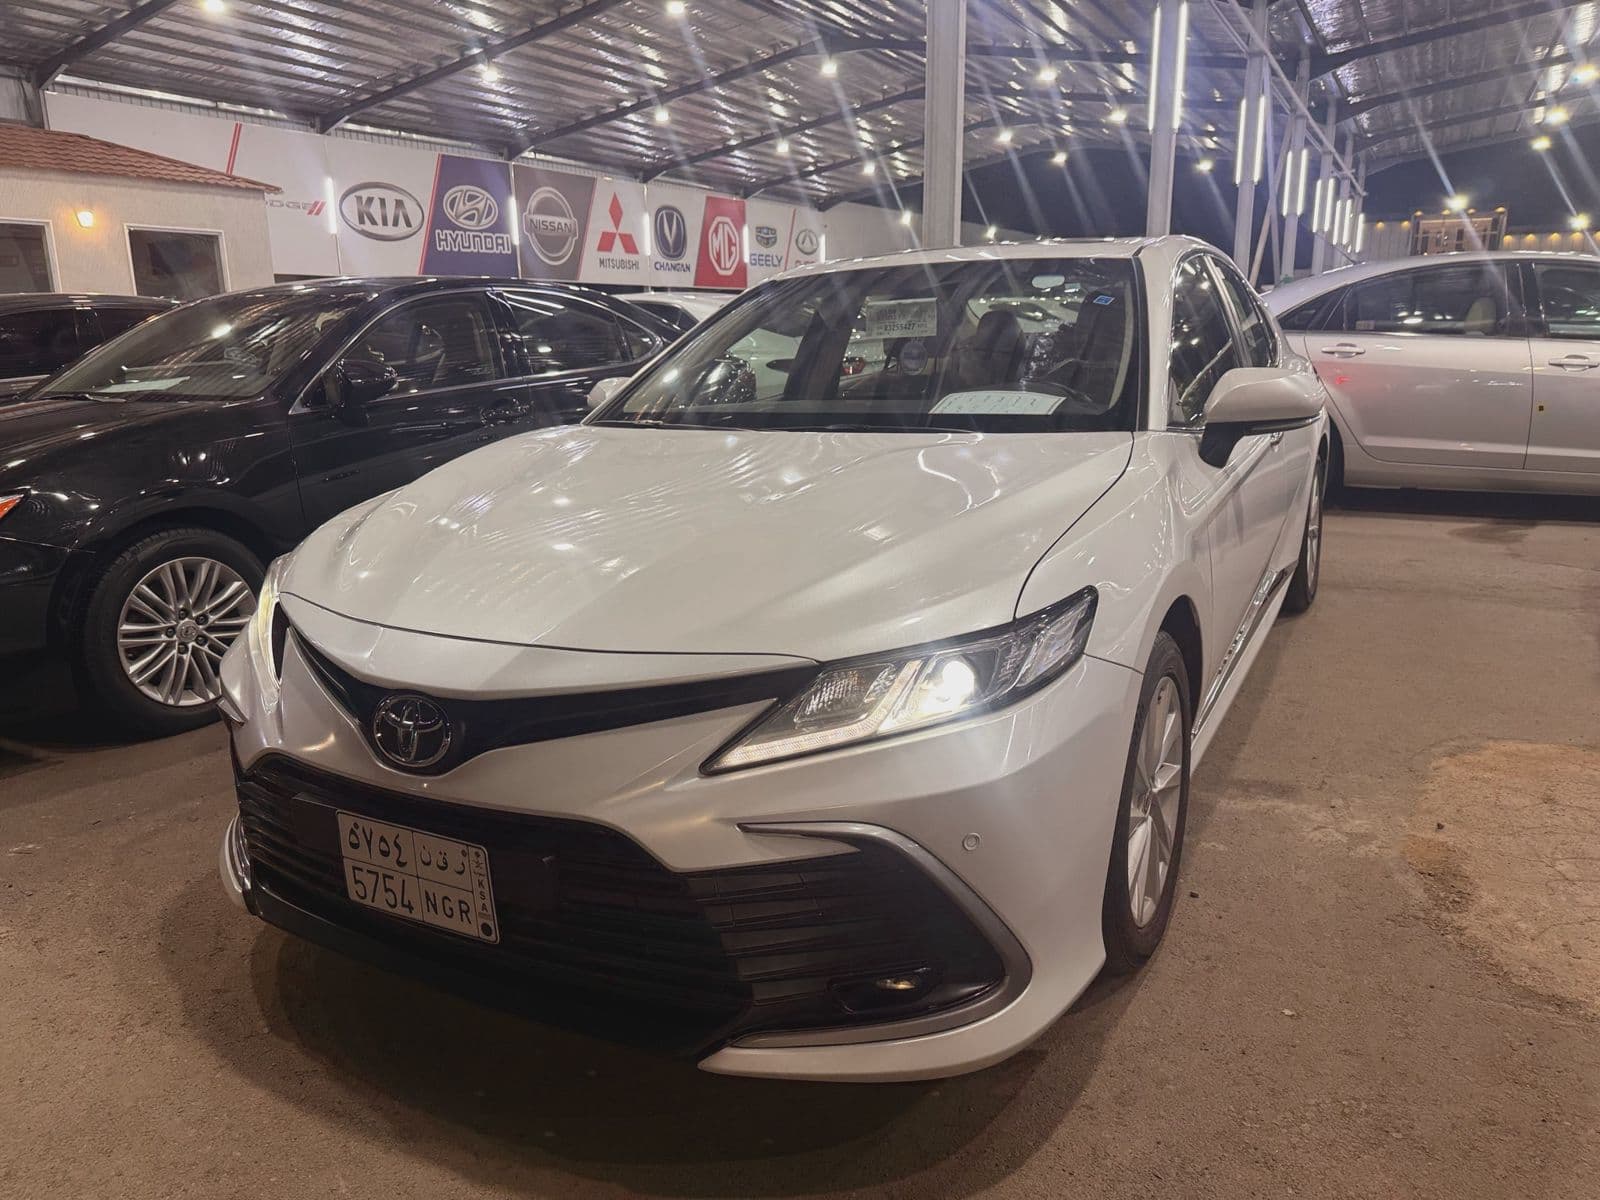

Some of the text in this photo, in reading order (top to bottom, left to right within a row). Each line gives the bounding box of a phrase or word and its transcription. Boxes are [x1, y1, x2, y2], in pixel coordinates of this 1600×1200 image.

[265, 199, 314, 211] DGE
[354, 194, 413, 228] KIA
[529, 218, 572, 233] NISSAN
[435, 229, 512, 254] HYUNDAI
[711, 222, 737, 269] MG
[599, 256, 640, 270] MITSUBISHI
[654, 261, 691, 273] CHANGAN
[749, 253, 783, 268] GEELY
[348, 826, 408, 868] ٥٧٥٤
[351, 865, 472, 924] 5754 NGR
[477, 879, 489, 913] KSA
